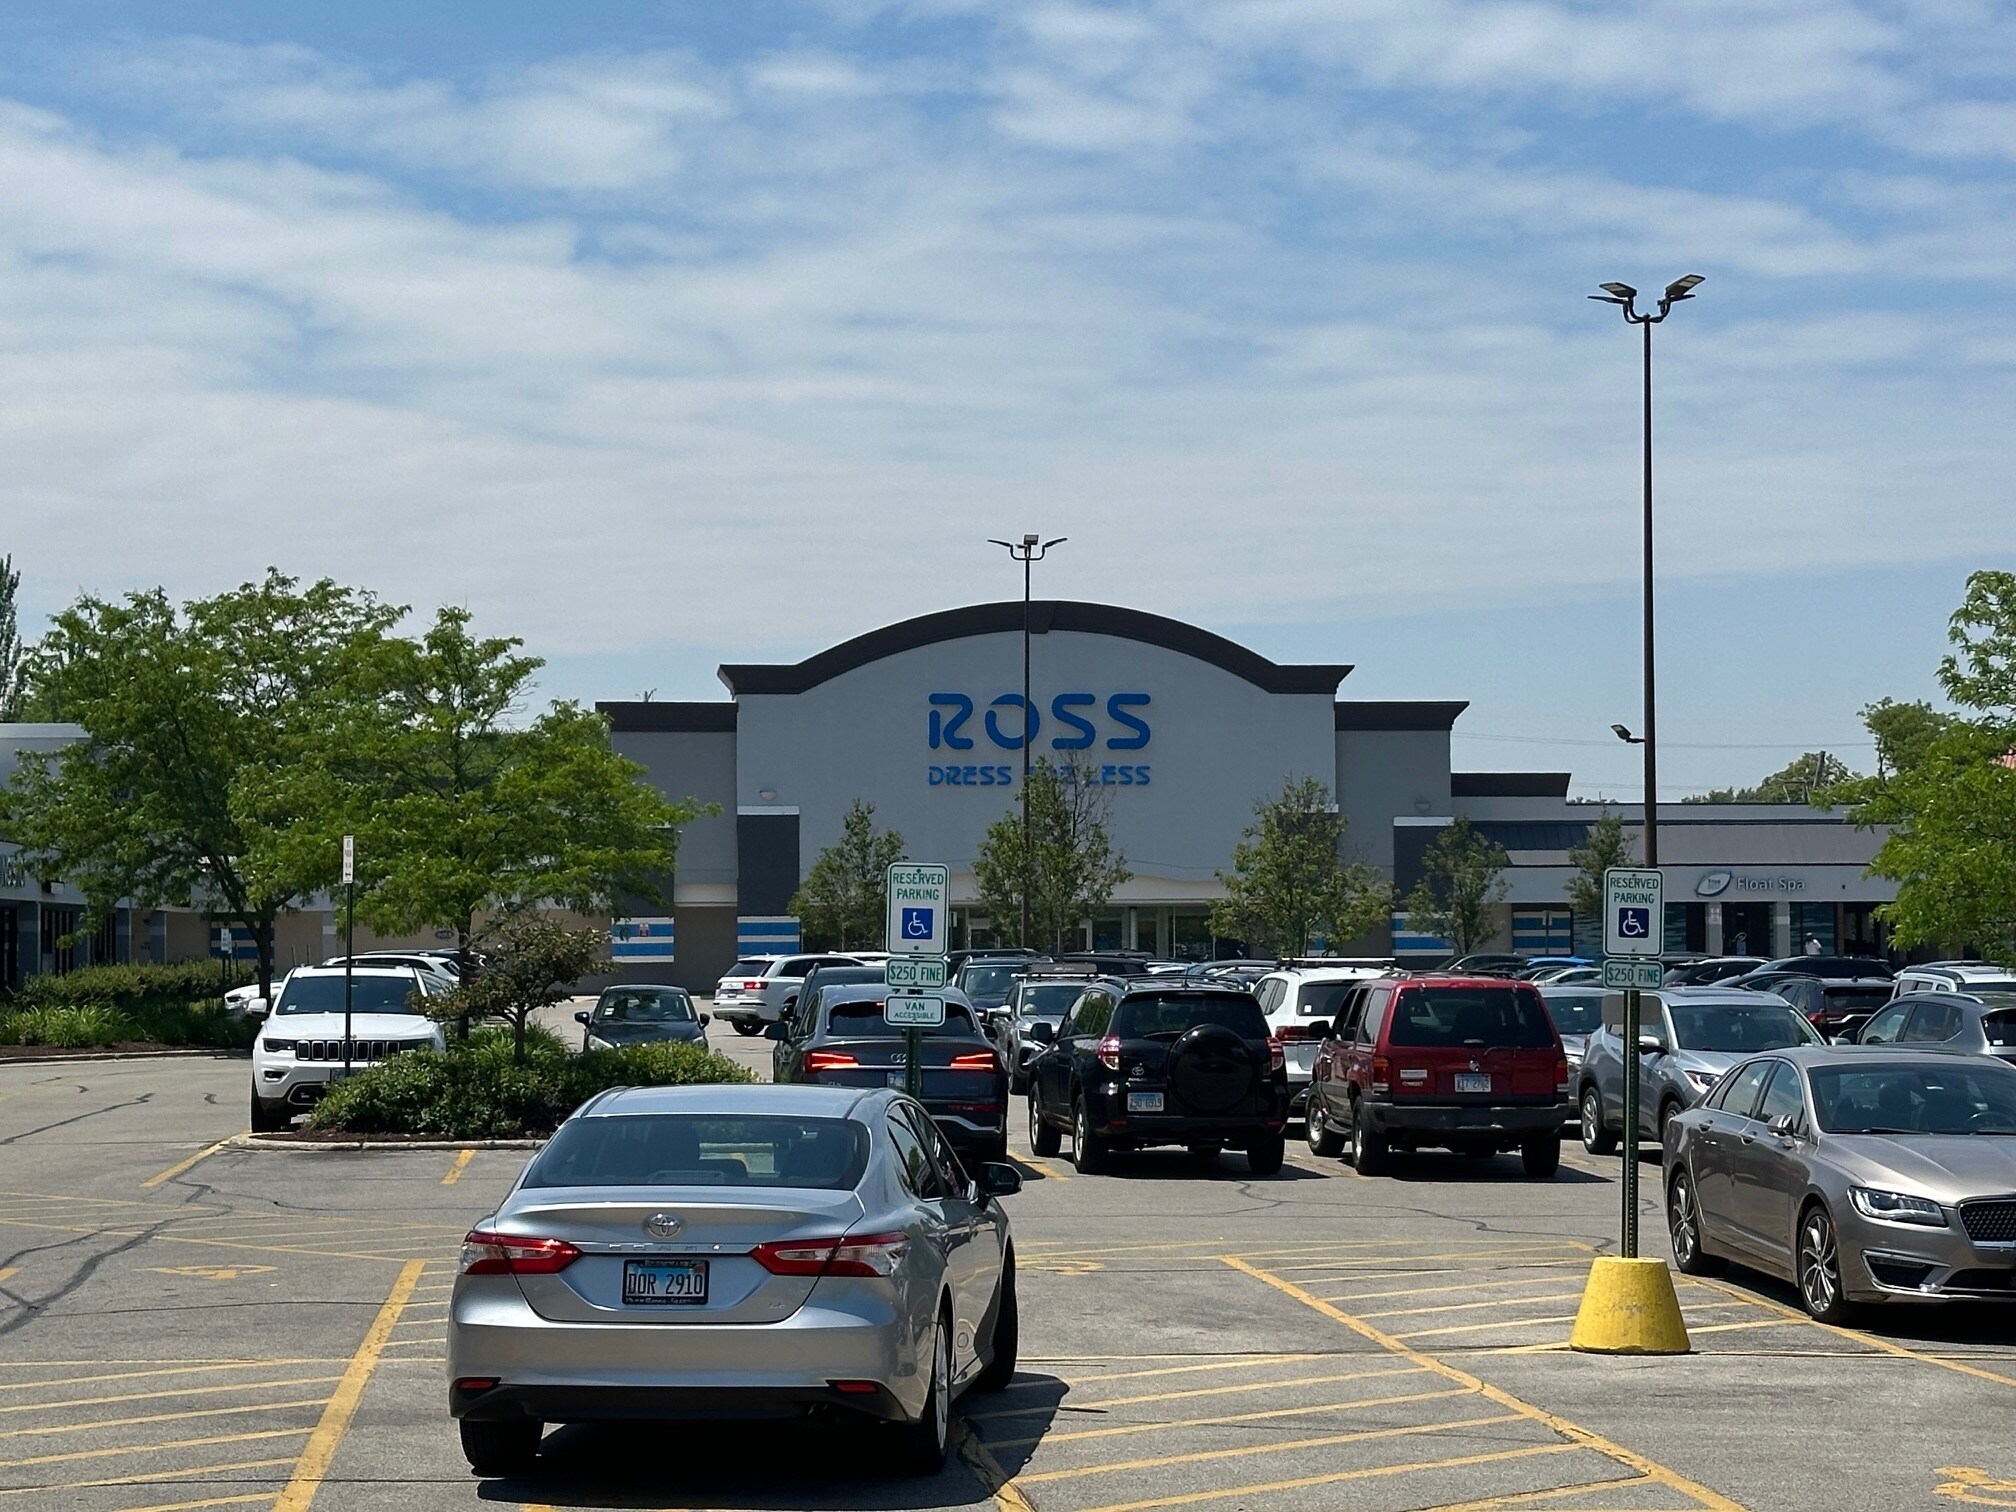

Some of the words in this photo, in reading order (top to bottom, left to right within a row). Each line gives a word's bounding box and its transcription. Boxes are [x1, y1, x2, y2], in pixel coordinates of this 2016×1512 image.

[928, 692, 1151, 750] ROSS
[928, 765, 1012, 786] DRESS
[892, 872, 944, 885] RESERVED
[1609, 877, 1659, 889] RESERVED
[1736, 877, 1774, 890] Float
[1778, 877, 1806, 893] Spa
[896, 888, 940, 900] PARKING
[1613, 892, 1655, 904] PARKING
[889, 965, 917, 980] $250
[920, 967, 942, 982] FINE
[1607, 967, 1634, 982] $250
[1638, 968, 1659, 983] FINE
[904, 1002, 926, 1011] VAN
[893, 1012, 935, 1020] ACCESSIBLE
[665, 1273, 703, 1295] 2910
